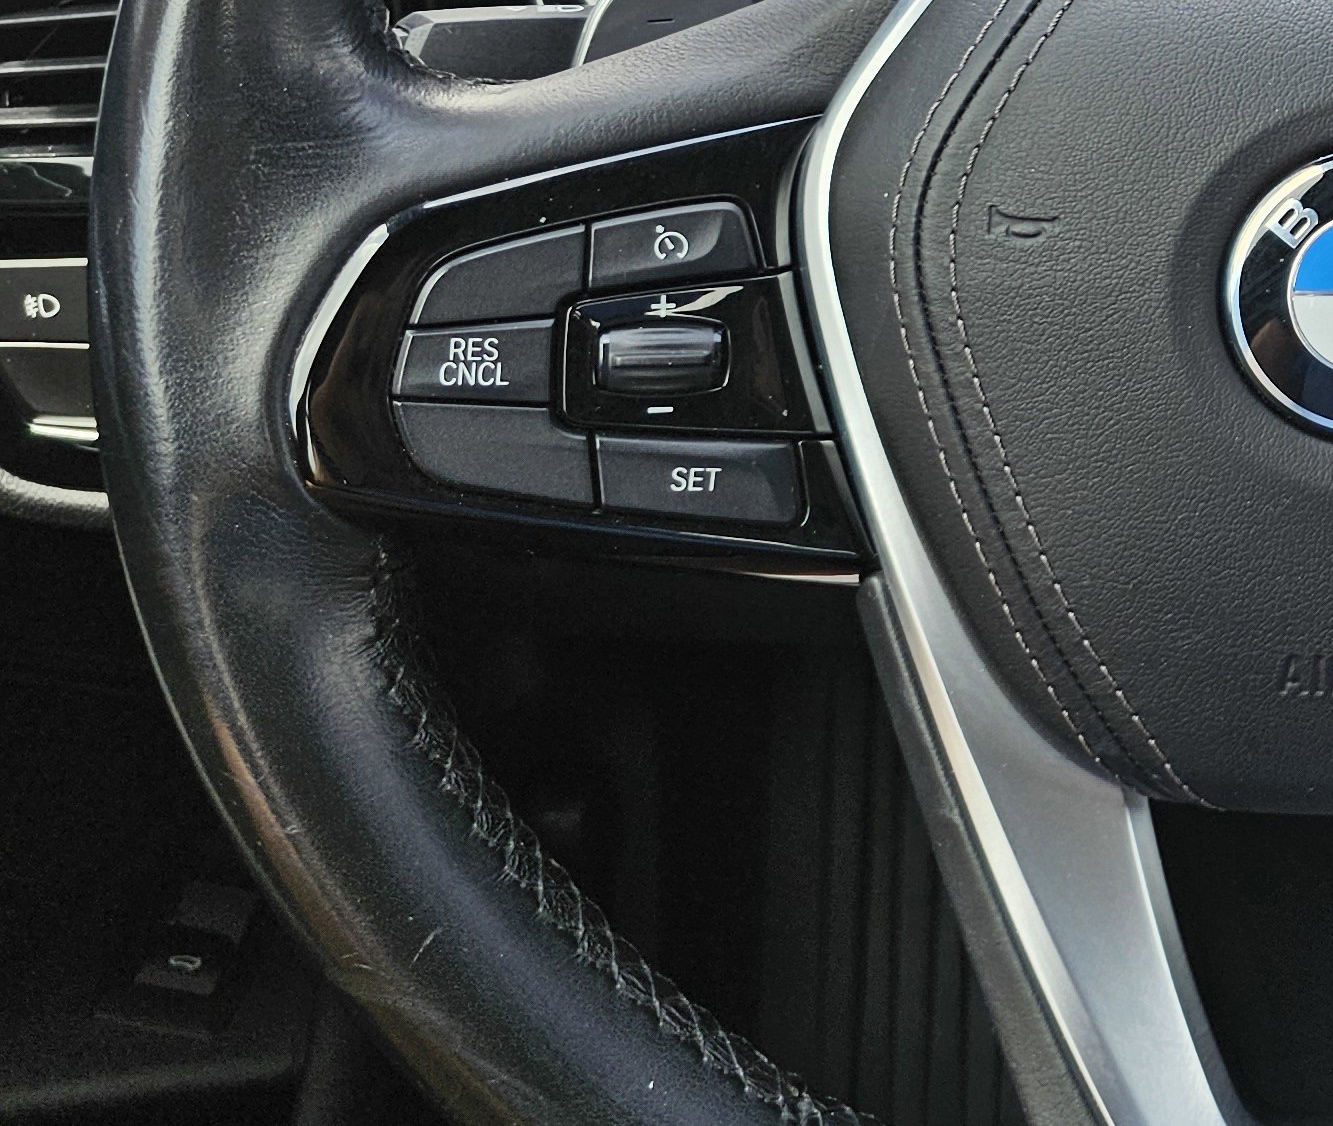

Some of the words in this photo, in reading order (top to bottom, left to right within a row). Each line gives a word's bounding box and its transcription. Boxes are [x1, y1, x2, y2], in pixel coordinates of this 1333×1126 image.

[449, 337, 499, 361] RES
[439, 361, 510, 387] CNCL
[670, 467, 722, 492] SET
